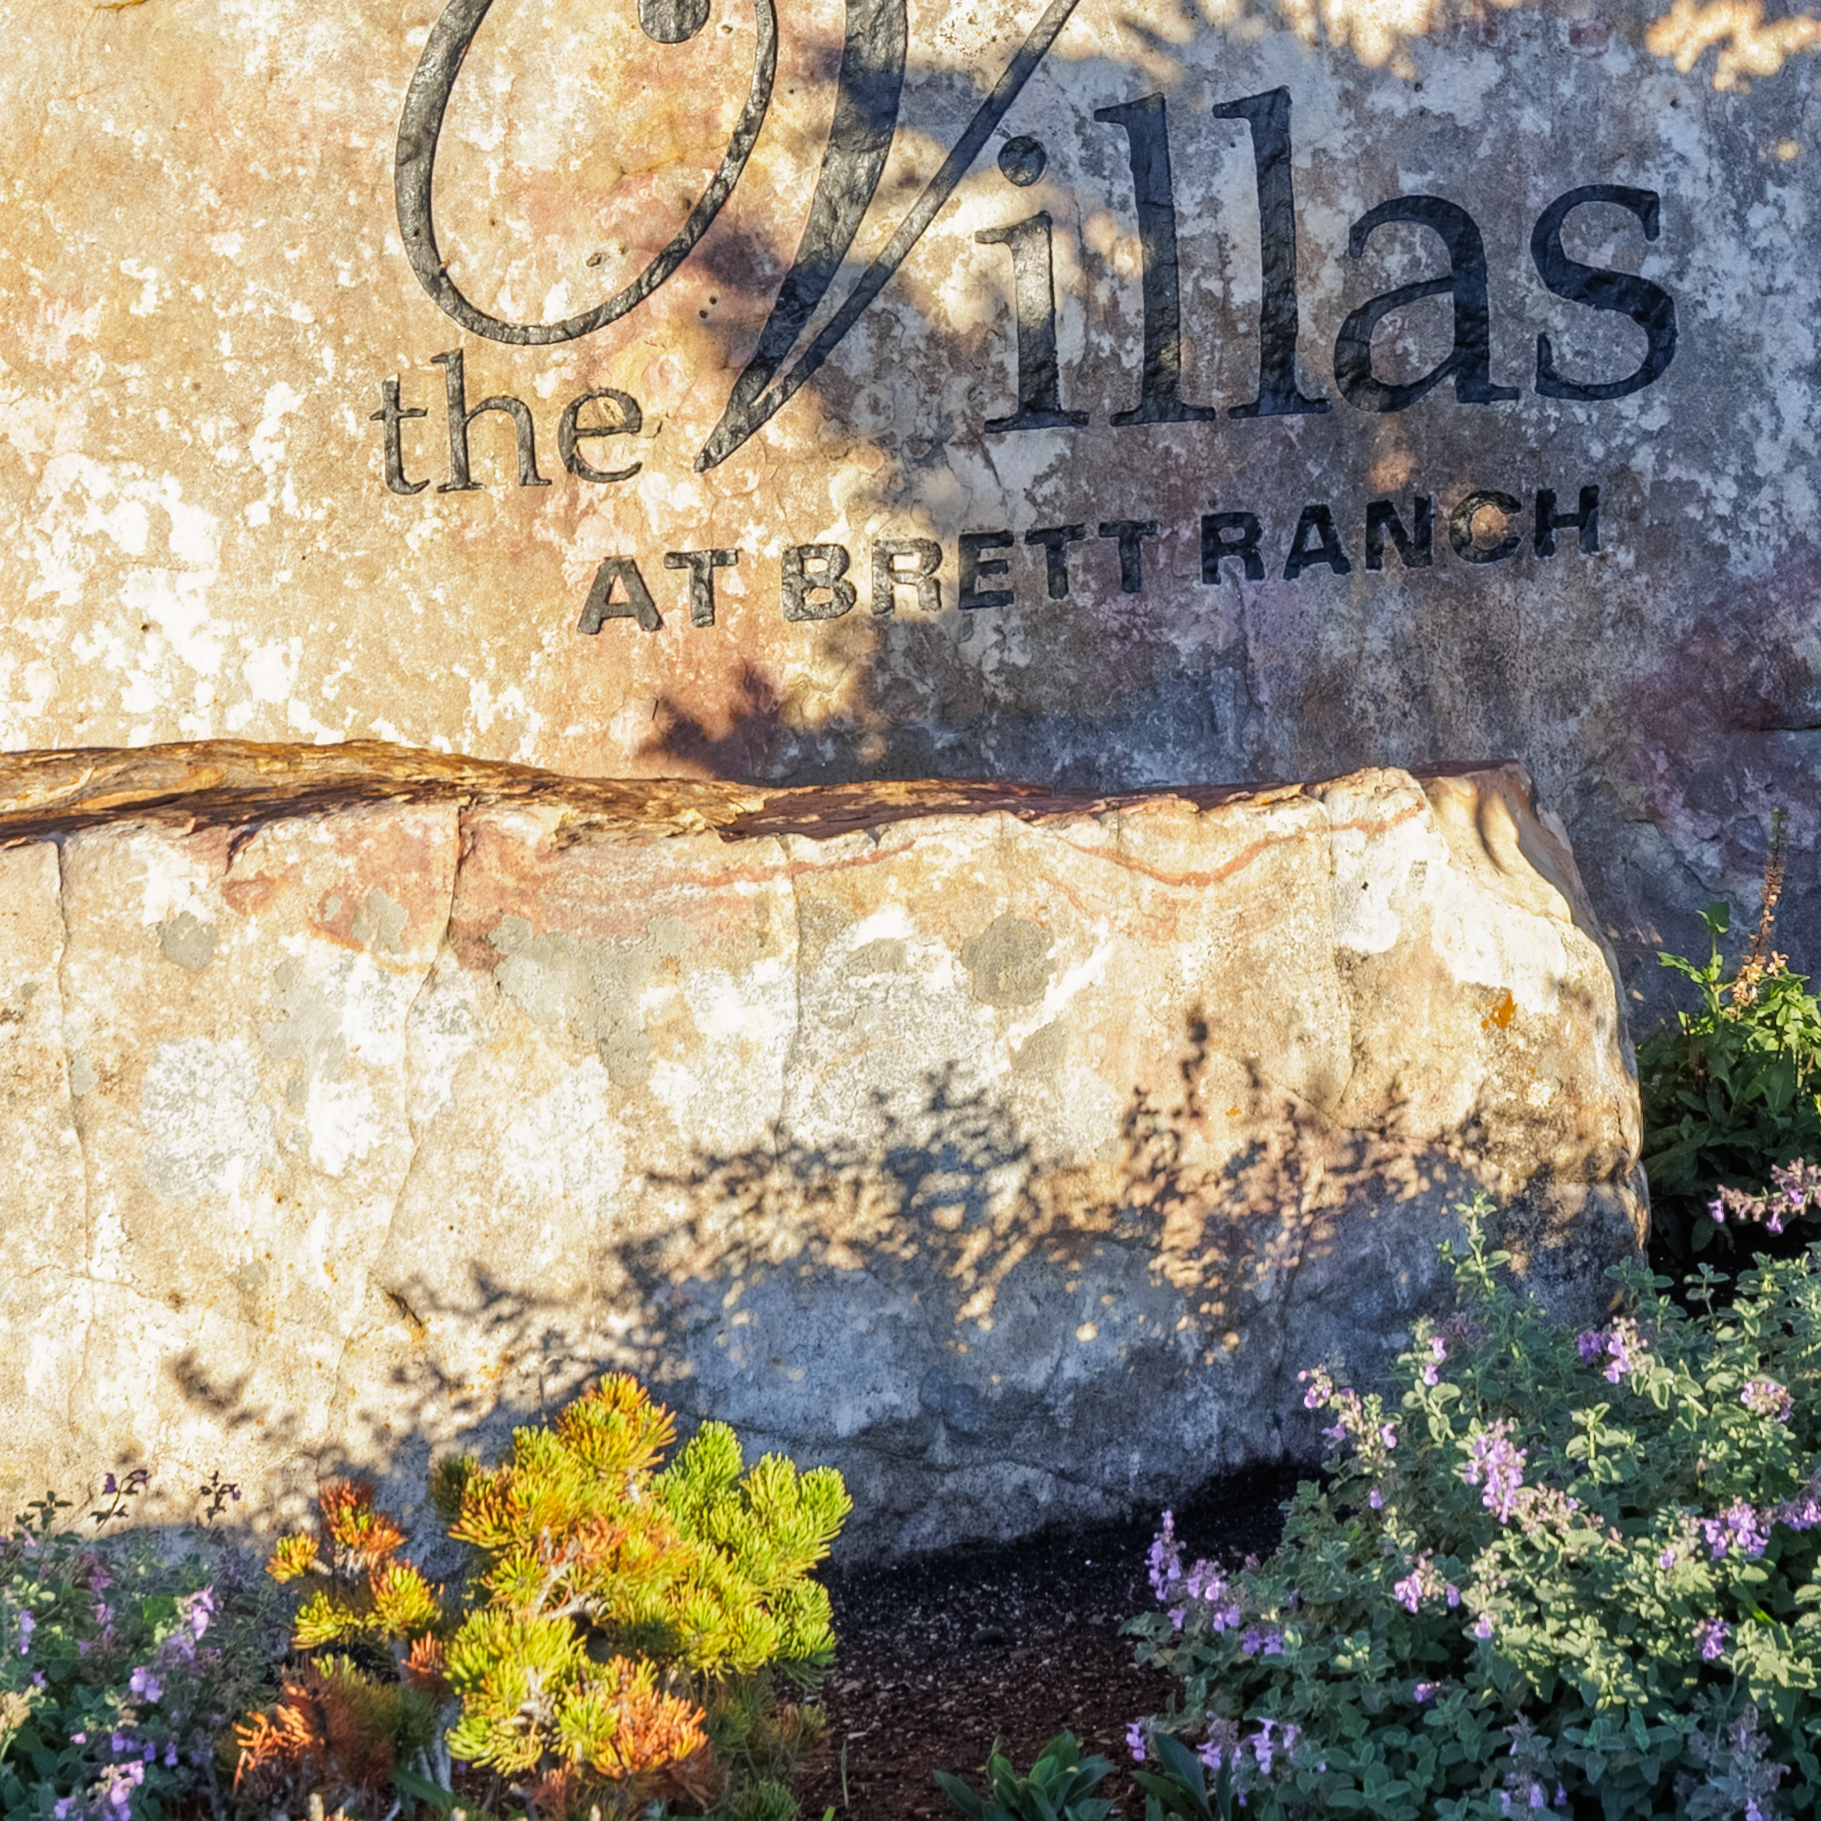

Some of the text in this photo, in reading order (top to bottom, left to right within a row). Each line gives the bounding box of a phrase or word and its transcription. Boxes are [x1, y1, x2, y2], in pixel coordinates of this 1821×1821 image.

[371, 350, 644, 495] the
[579, 485, 1599, 633] AT BRETT RANCH
